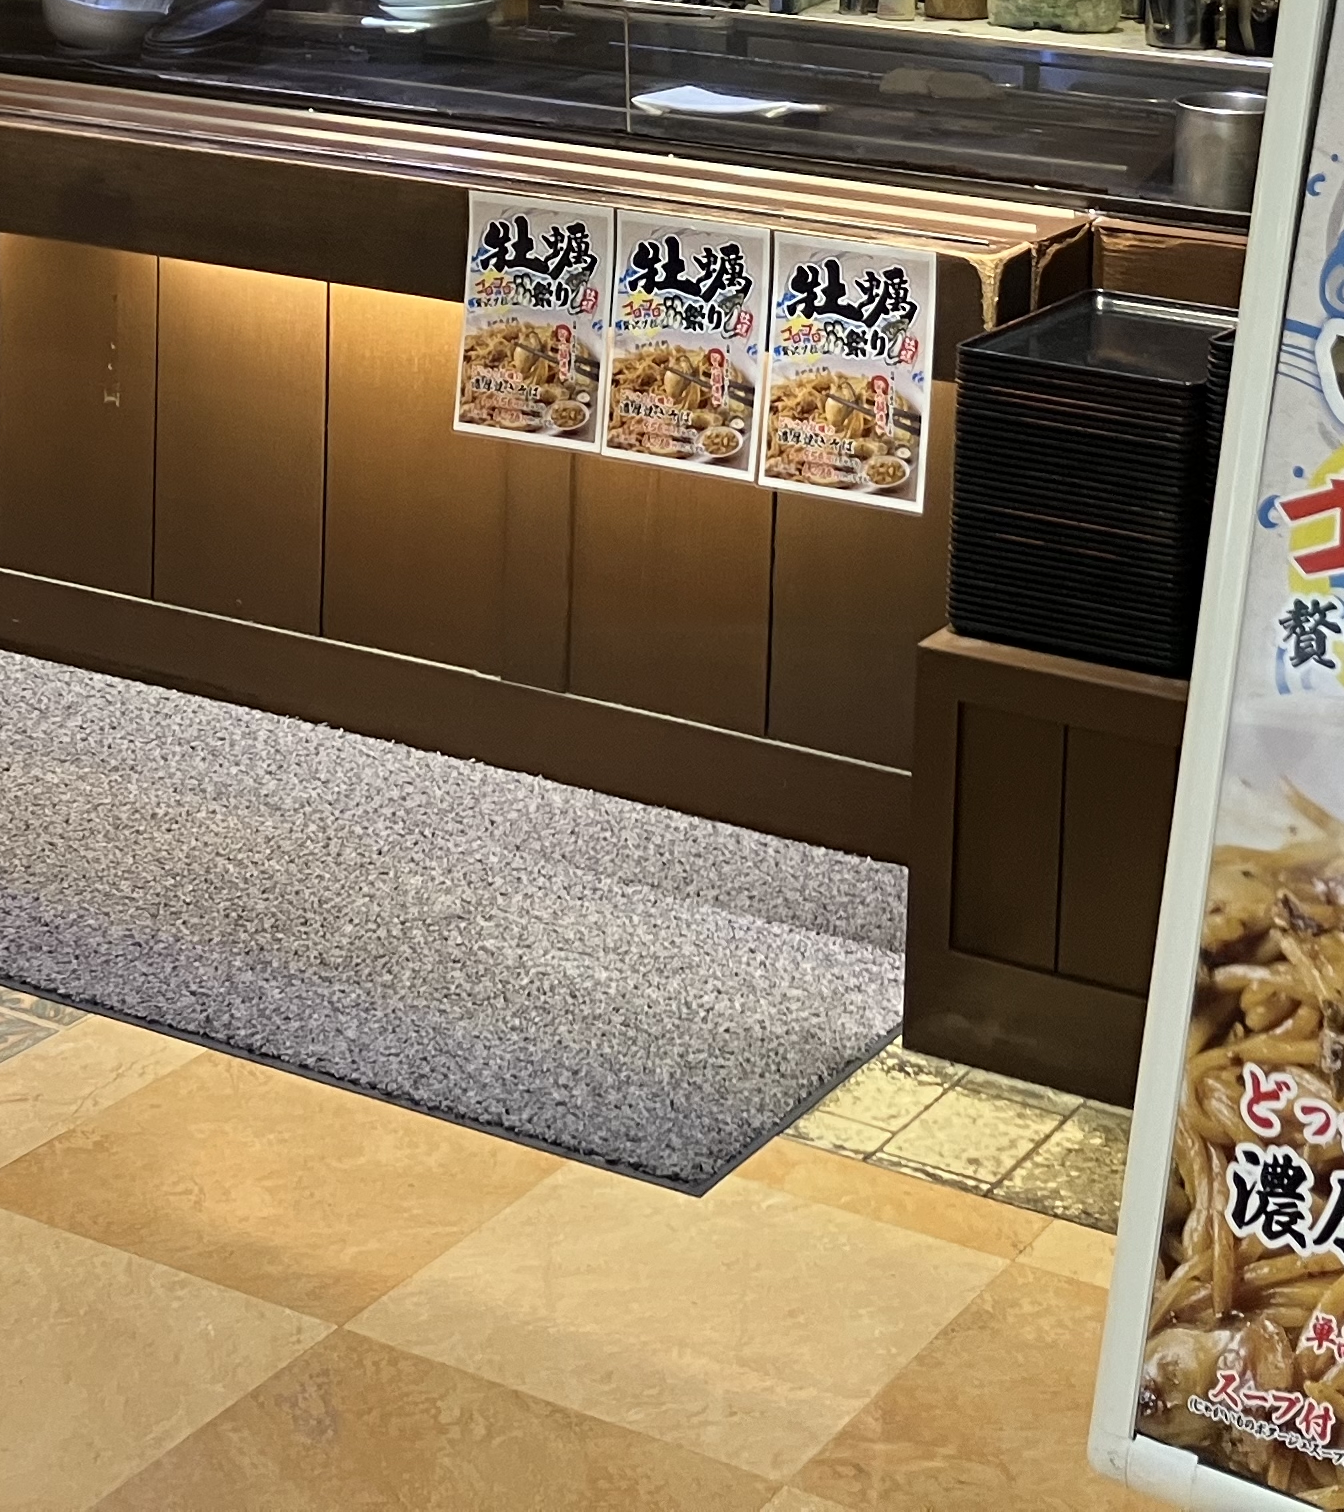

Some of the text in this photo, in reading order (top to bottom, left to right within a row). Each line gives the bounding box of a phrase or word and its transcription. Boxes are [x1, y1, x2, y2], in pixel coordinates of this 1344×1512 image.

[479, 215, 599, 281] 牡蠣
[626, 235, 754, 304] 牡蠣
[474, 276, 513, 297] ゴロゴロ
[532, 280, 571, 309] 祭り
[786, 258, 919, 329] 牡蠣
[622, 298, 663, 320] ゴロゴロ
[683, 303, 724, 333] 祭り
[780, 322, 823, 346] ゴロゴロ
[845, 328, 888, 360] 祭り
[1210, 1372, 1336, 1442] スープ付
